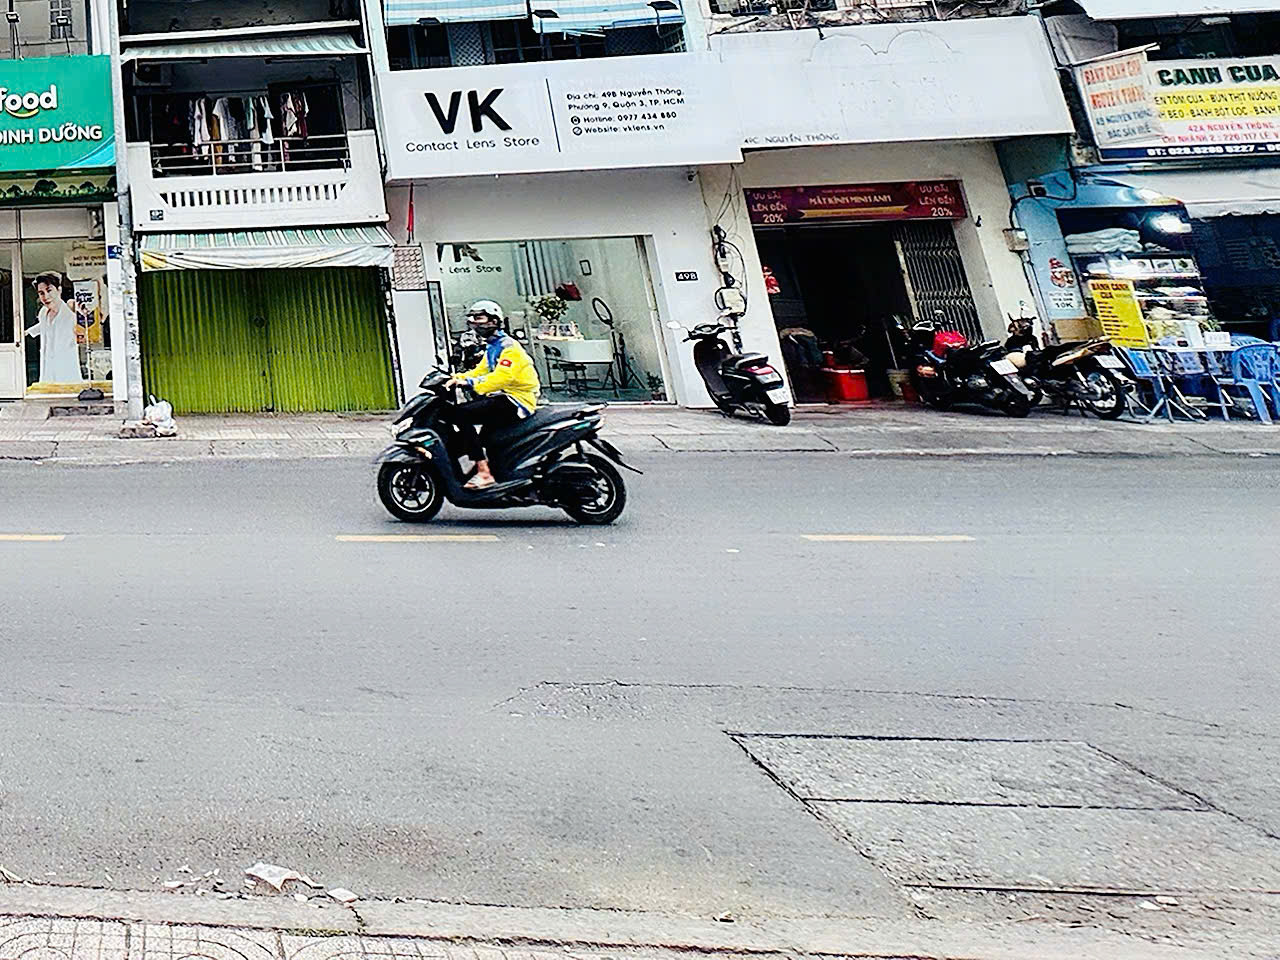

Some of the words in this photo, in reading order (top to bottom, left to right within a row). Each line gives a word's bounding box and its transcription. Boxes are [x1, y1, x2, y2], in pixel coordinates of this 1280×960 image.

[1157, 67, 1223, 87] CANH
[1227, 64, 1280, 84] CUA
[424, 88, 512, 134] VK
[38, 122, 103, 142] DƯỠNG
[406, 141, 459, 152] Contact
[466, 139, 496, 149] Lens
[503, 136, 540, 147] Store
[762, 213, 784, 223] 20%
[931, 207, 953, 217] 20%
[476, 265, 502, 273] Store
[678, 272, 697, 280] 49B
